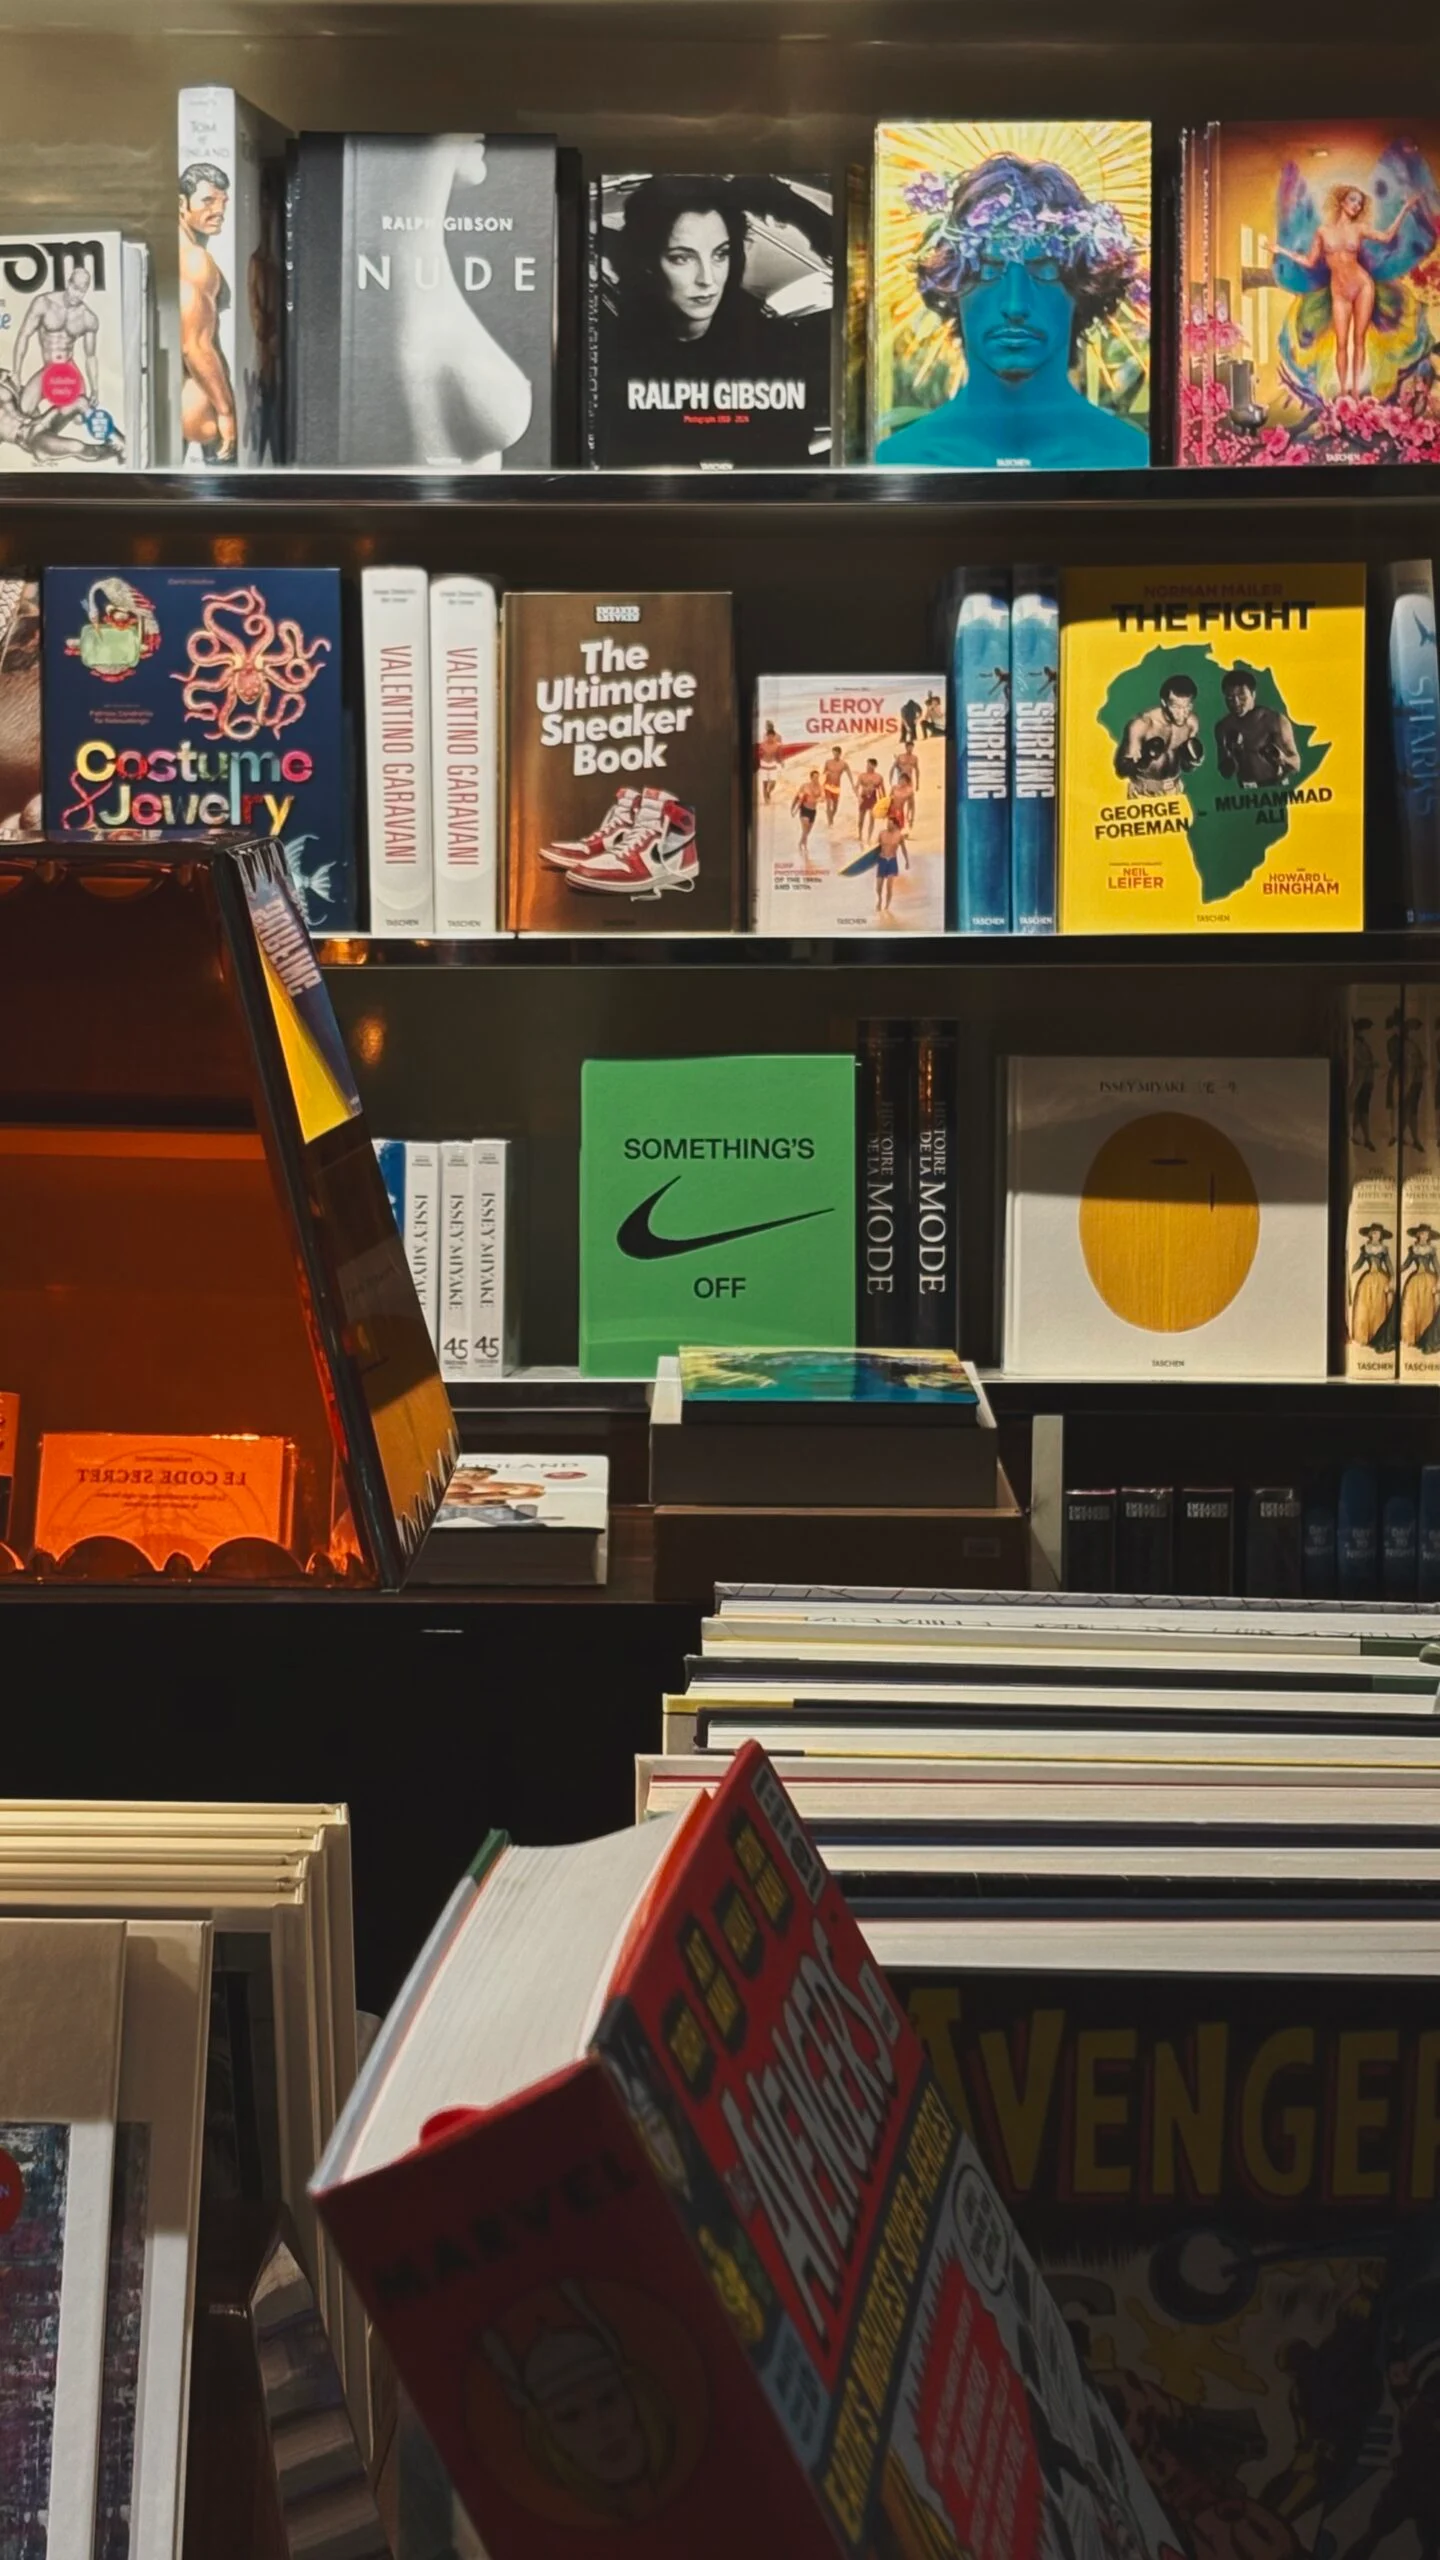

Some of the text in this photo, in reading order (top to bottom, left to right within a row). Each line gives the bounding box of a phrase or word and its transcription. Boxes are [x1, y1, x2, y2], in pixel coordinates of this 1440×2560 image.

[381, 215, 514, 232] RALPH GIBSON
[357, 255, 537, 292] NUDE
[627, 380, 807, 411] RALPH GIBSON
[996, 458, 1032, 467] TASCHEN
[1325, 452, 1361, 462] TASCHEN
[1143, 583, 1284, 597] NORMAN MAILER
[1111, 600, 1316, 632] THE FIGHT
[580, 639, 649, 673] The
[536, 671, 697, 713] Ultimate
[818, 698, 884, 714] LEROY
[540, 705, 694, 746] Sneaker
[805, 717, 899, 734] GRANNIS
[380, 645, 416, 865] VALENTINO GARAVANI
[446, 647, 480, 866] VALENTINO GARAVANI
[573, 741, 667, 776] Book
[967, 702, 1008, 799] SURFING
[1015, 701, 1056, 798] SURFING
[76, 740, 313, 783] Costume
[98, 783, 295, 837] Jewelry
[1214, 787, 1333, 812] MUHAMMAD
[1100, 801, 1180, 822] GEORGE
[1255, 809, 1287, 825] ALI
[1094, 818, 1189, 840] FOREMAN
[1108, 877, 1164, 890] LEIFER
[1122, 868, 1149, 877] NEIL
[1268, 873, 1321, 882] HOWARD
[1262, 883, 1340, 895] BINGHAM
[385, 919, 419, 928] TASCHEN
[447, 920, 481, 928] TASCHEN
[972, 917, 1005, 926] TASCHEN
[1019, 916, 1053, 925] TASCHEN
[1196, 915, 1231, 923] TASCHEN
[919, 1131, 932, 1176] DE LA
[867, 1156, 880, 1176] LA
[413, 1195, 429, 1242] ISSEY
[479, 1192, 496, 1308] ISSEY MIYAKE
[866, 1181, 894, 1296] MODE
[918, 1181, 947, 1296] MODE
[449, 1195, 465, 1310] ISSEY MIYAKE
[693, 1277, 747, 1299] OFF
[443, 1337, 469, 1360] 45
[474, 1335, 499, 1358] 45
[1151, 1359, 1185, 1367] TASCHEN
[1357, 1362, 1394, 1371] TASCHEN
[718, 1915, 895, 2341] AVENGERS
[373, 2153, 639, 2304] MARVEL
